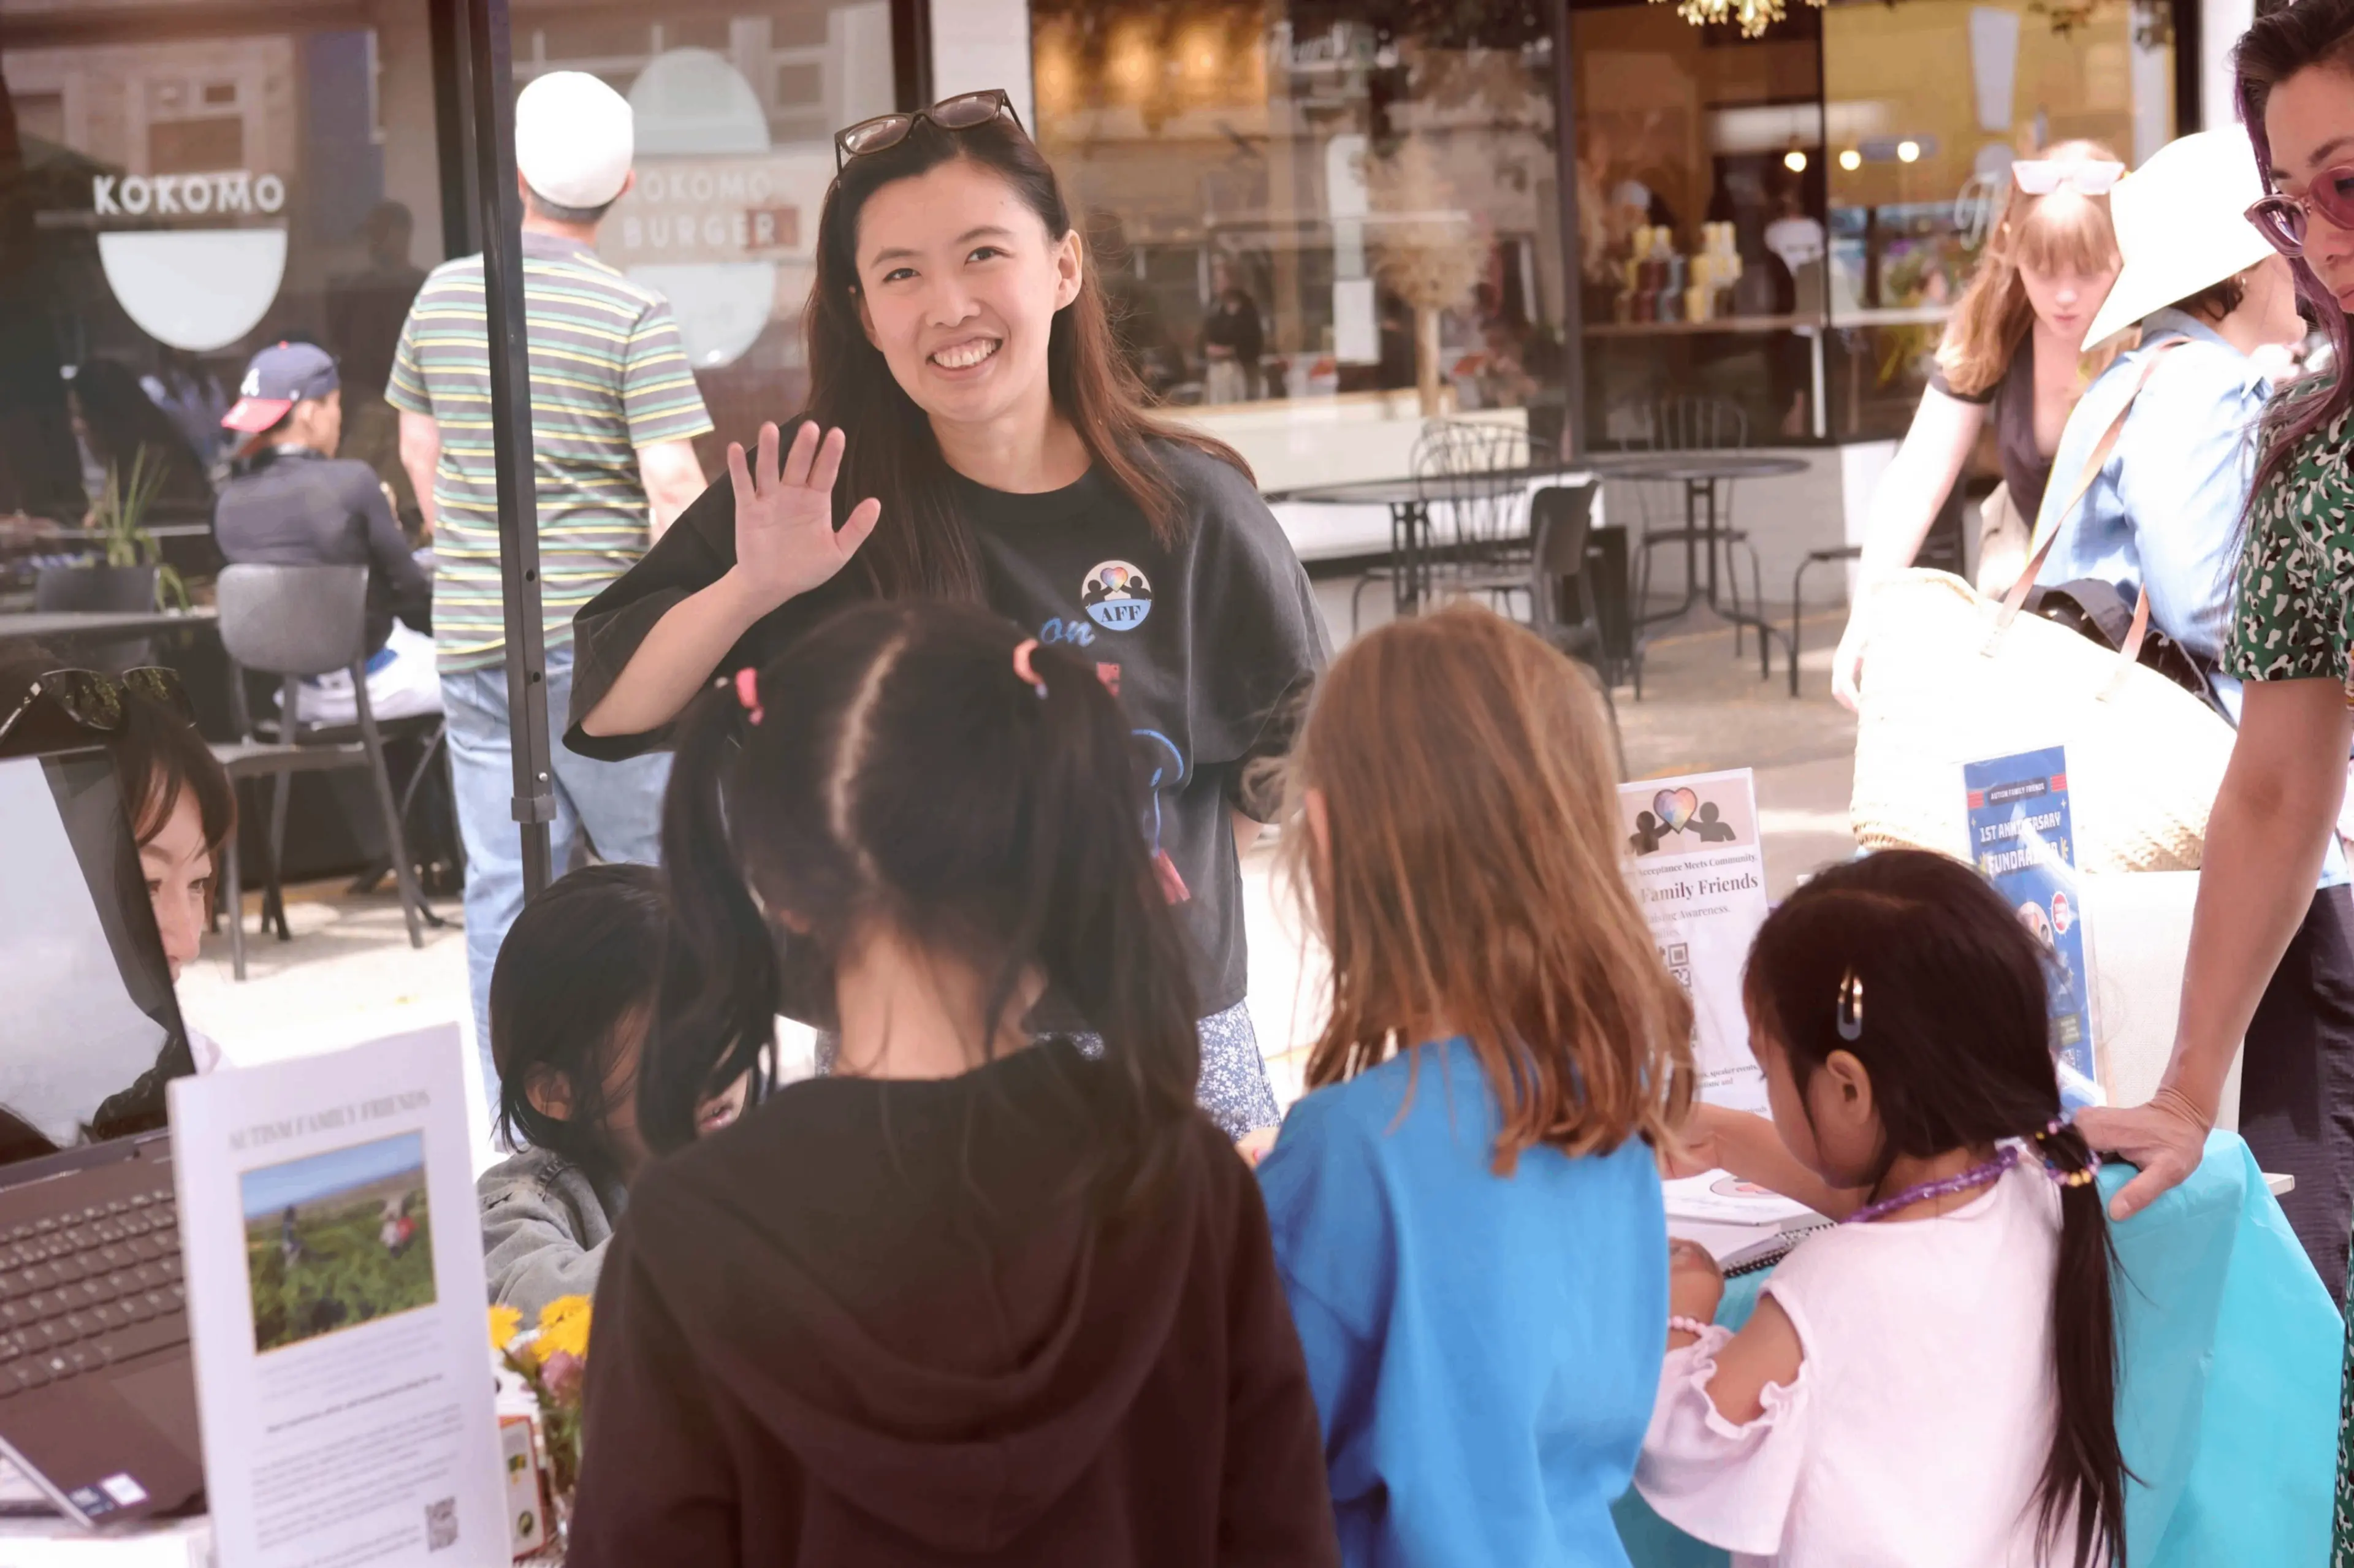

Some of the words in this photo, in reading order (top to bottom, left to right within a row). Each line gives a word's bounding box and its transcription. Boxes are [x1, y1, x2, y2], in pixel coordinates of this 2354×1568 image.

[93, 174, 285, 215] KOKOMO
[621, 169, 772, 203] OKOMO
[622, 212, 775, 249] BURGER
[1102, 605, 1141, 623] AFF
[1990, 790, 2008, 800] AUTISM
[2008, 786, 2025, 797] FAMILY
[2025, 782, 2045, 793] FRIENDS
[1979, 824, 1997, 843] 1ST
[1683, 860, 1708, 870] Meets
[1640, 881, 1694, 904] Family
[1697, 872, 1759, 896] Friends
